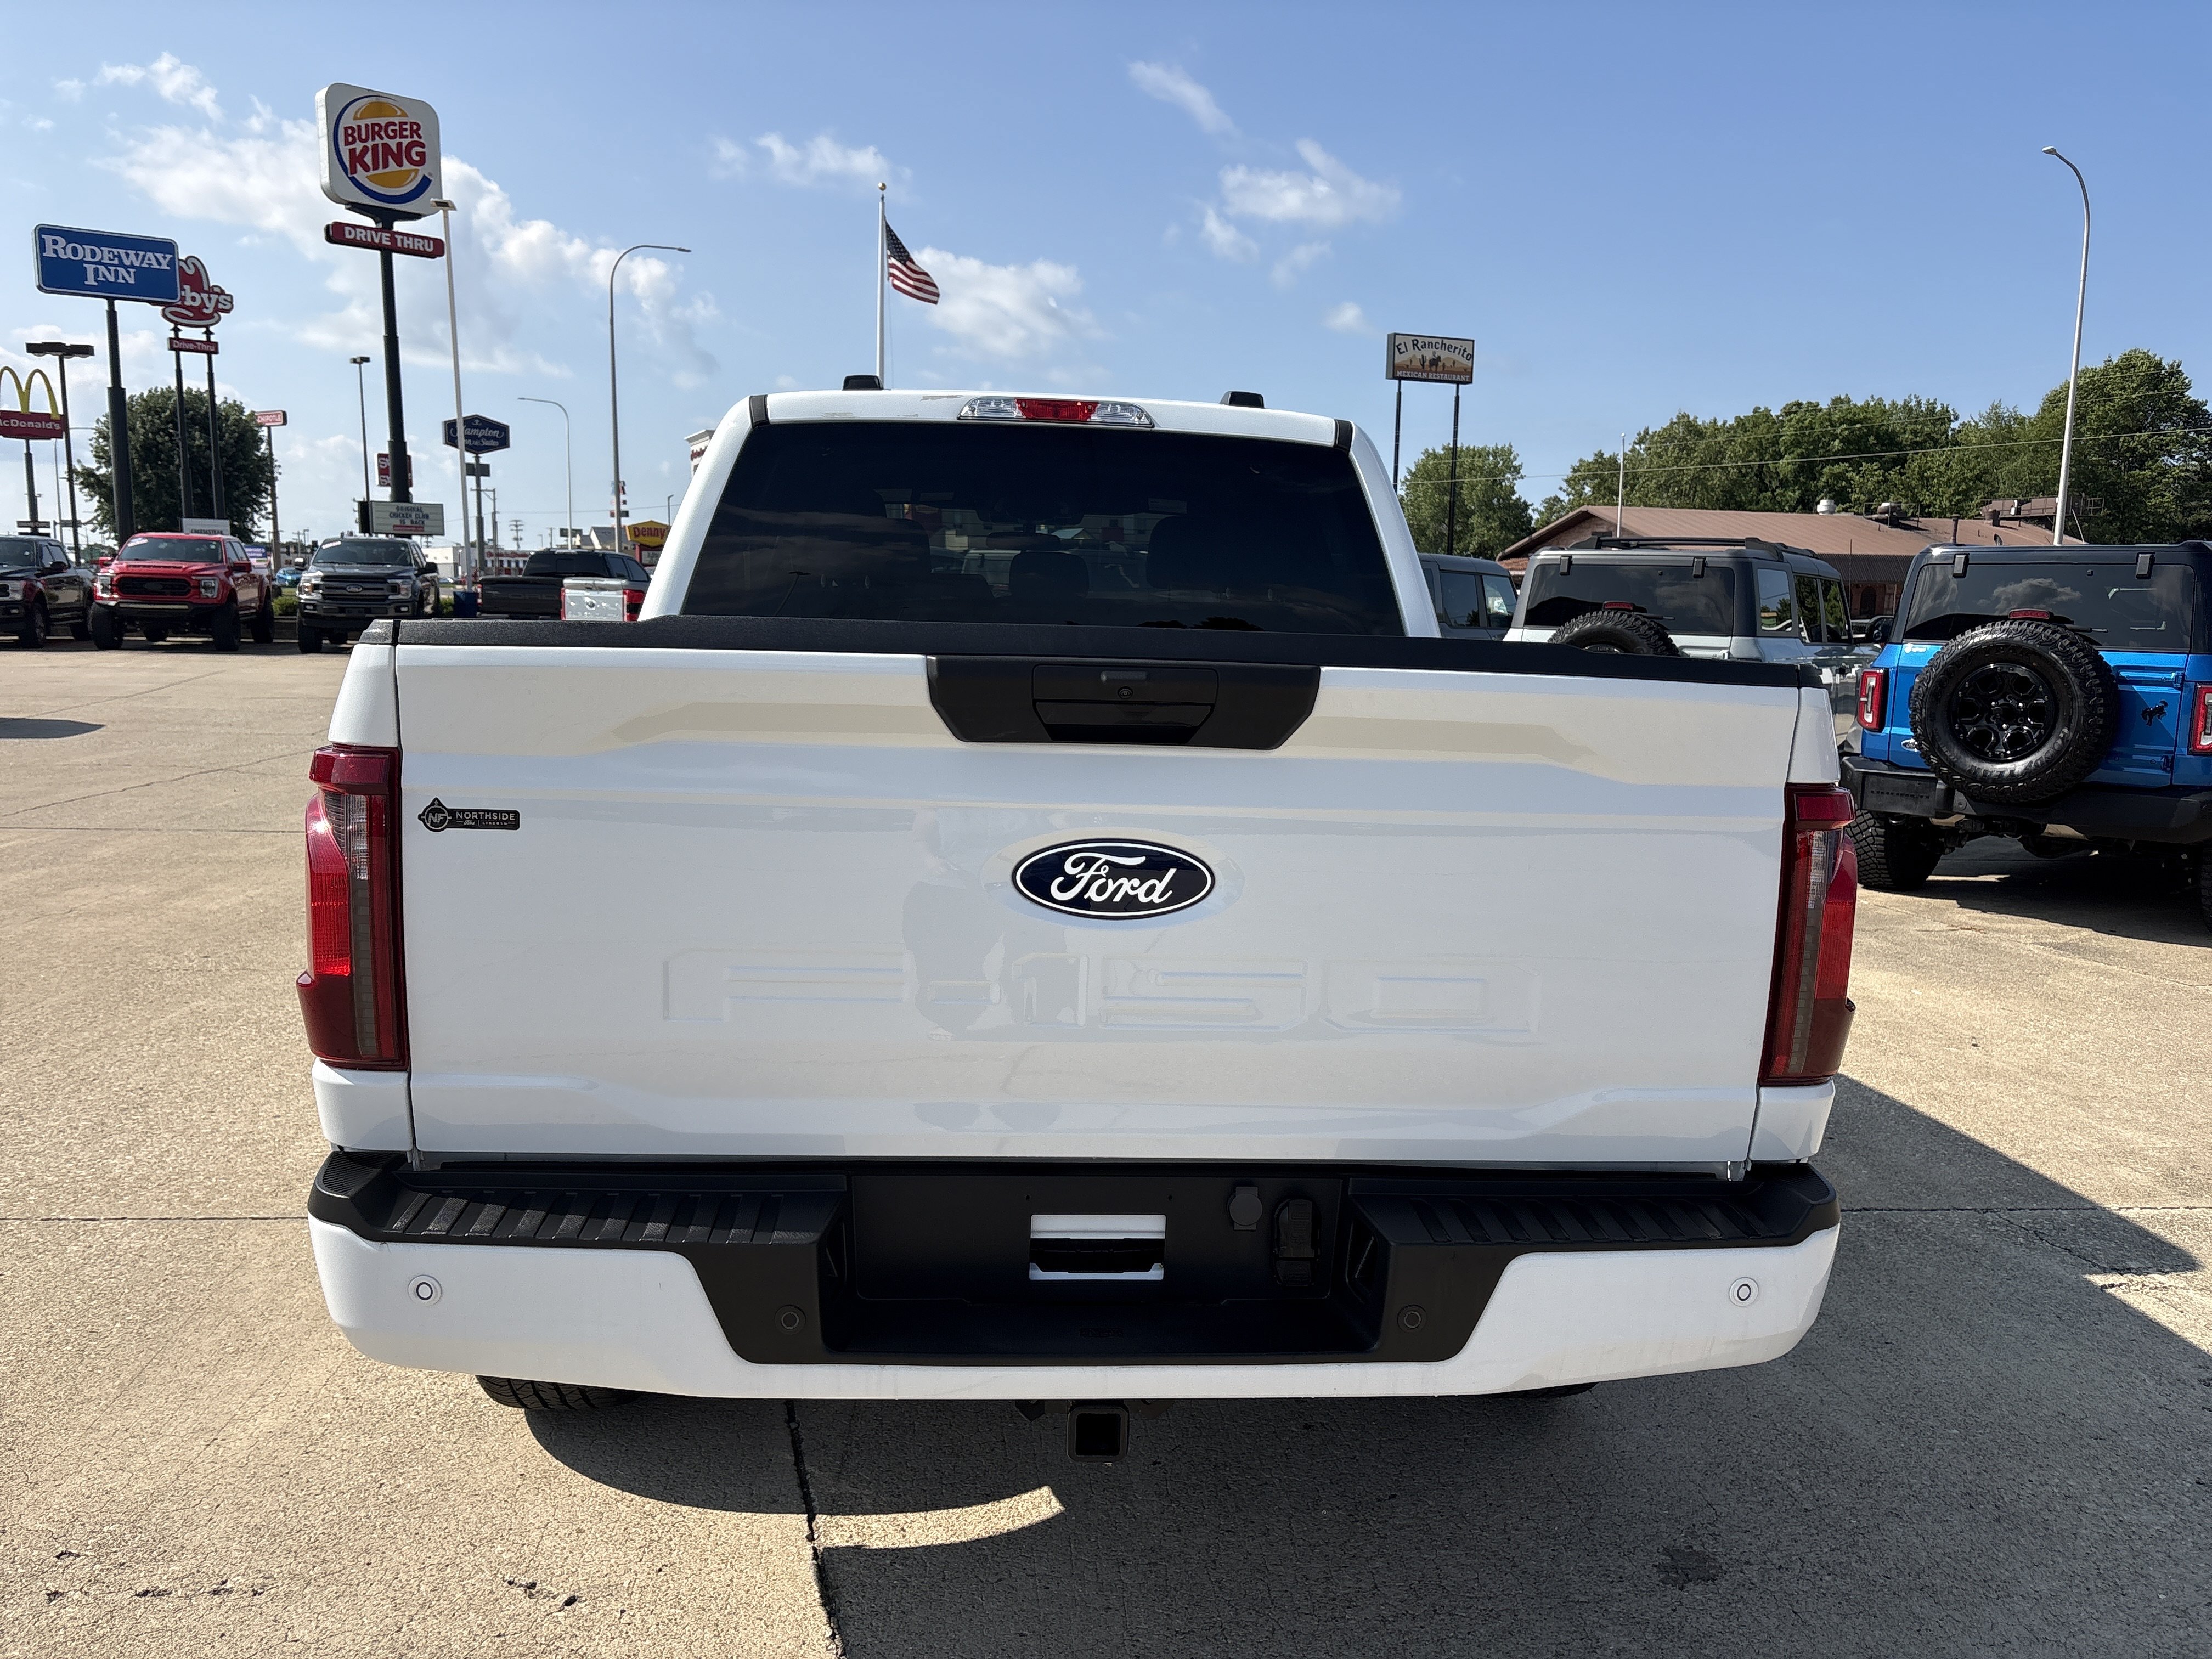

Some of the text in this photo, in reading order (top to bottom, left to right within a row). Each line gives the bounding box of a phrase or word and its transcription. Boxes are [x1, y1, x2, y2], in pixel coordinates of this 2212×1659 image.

[343, 121, 422, 146] BURGER
[348, 140, 426, 176] KING
[344, 226, 435, 252] DRIVE THRU
[83, 263, 137, 286] INN
[180, 285, 233, 314] by's
[173, 340, 215, 352] Drive-Thru
[1396, 338, 1472, 362] El Rancherito
[1396, 370, 1470, 382] MEXICAN RESTAURANT
[456, 811, 515, 821] NORTHSIDE
[1050, 852, 1178, 904] Ford
